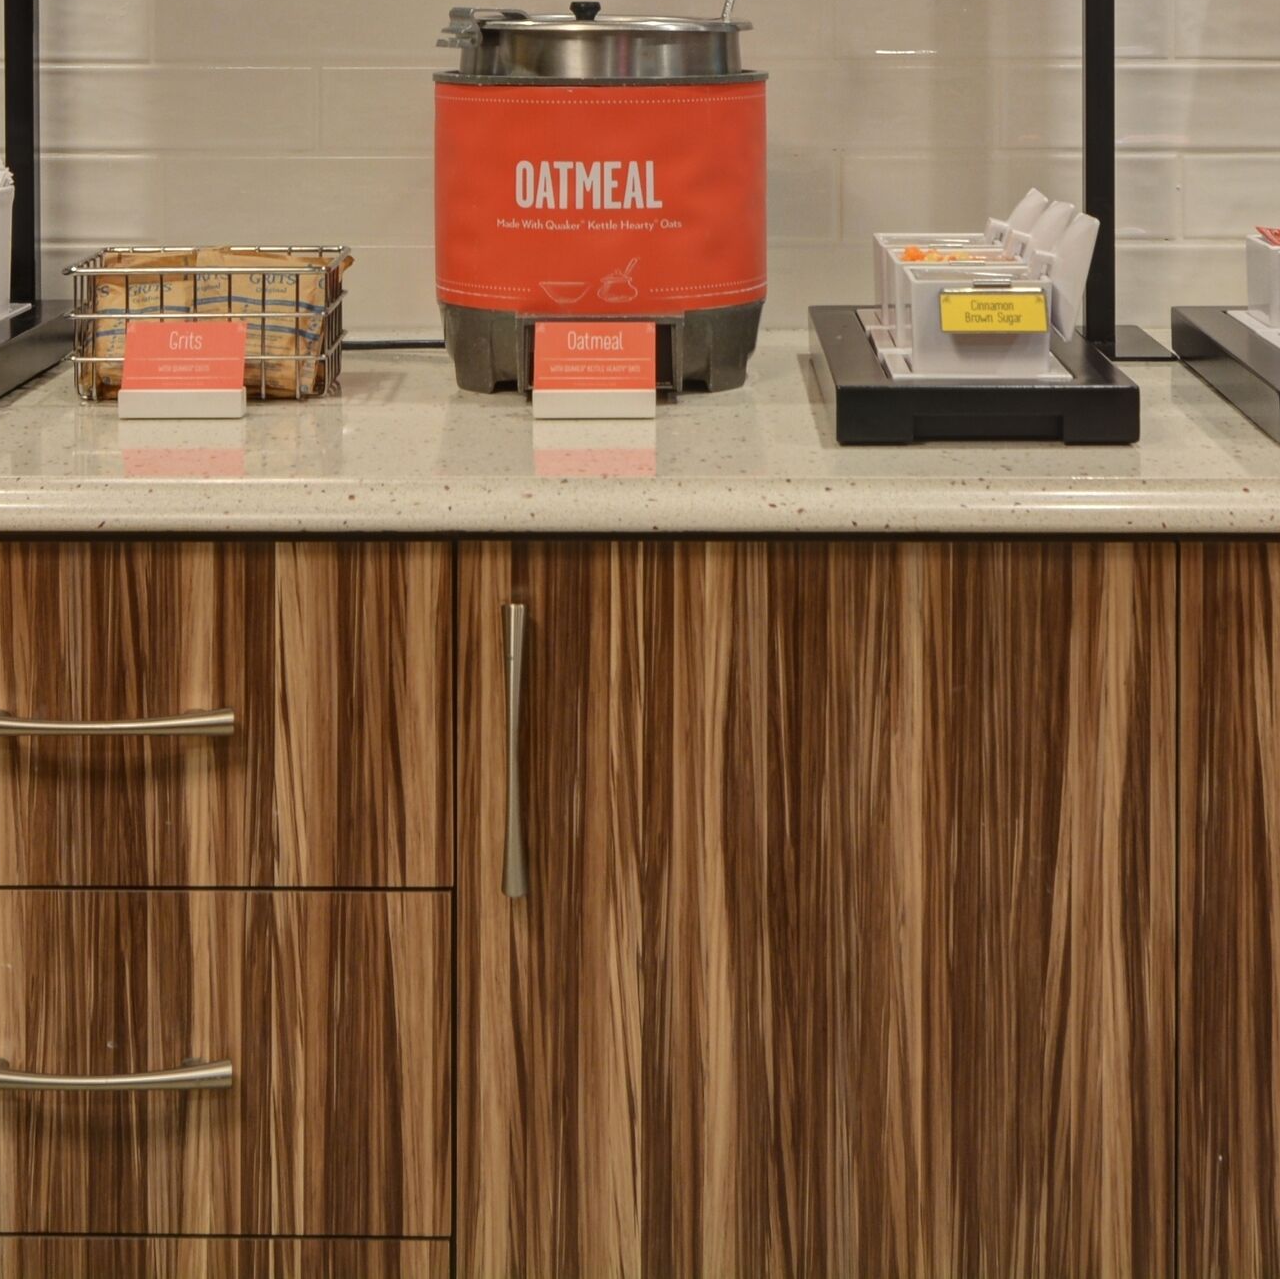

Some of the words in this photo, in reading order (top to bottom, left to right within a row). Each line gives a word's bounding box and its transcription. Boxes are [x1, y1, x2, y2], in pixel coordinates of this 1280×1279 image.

[515, 160, 663, 210] OATMEAL
[496, 219, 520, 229] Made
[521, 220, 543, 229] With
[587, 220, 618, 230] Kettle
[660, 219, 682, 229] Oats
[970, 300, 1014, 311] Cinnamon
[965, 312, 993, 323] Brown
[997, 312, 1022, 325] Sugar
[168, 330, 203, 351] Grits
[567, 330, 624, 351] Oatmeal
